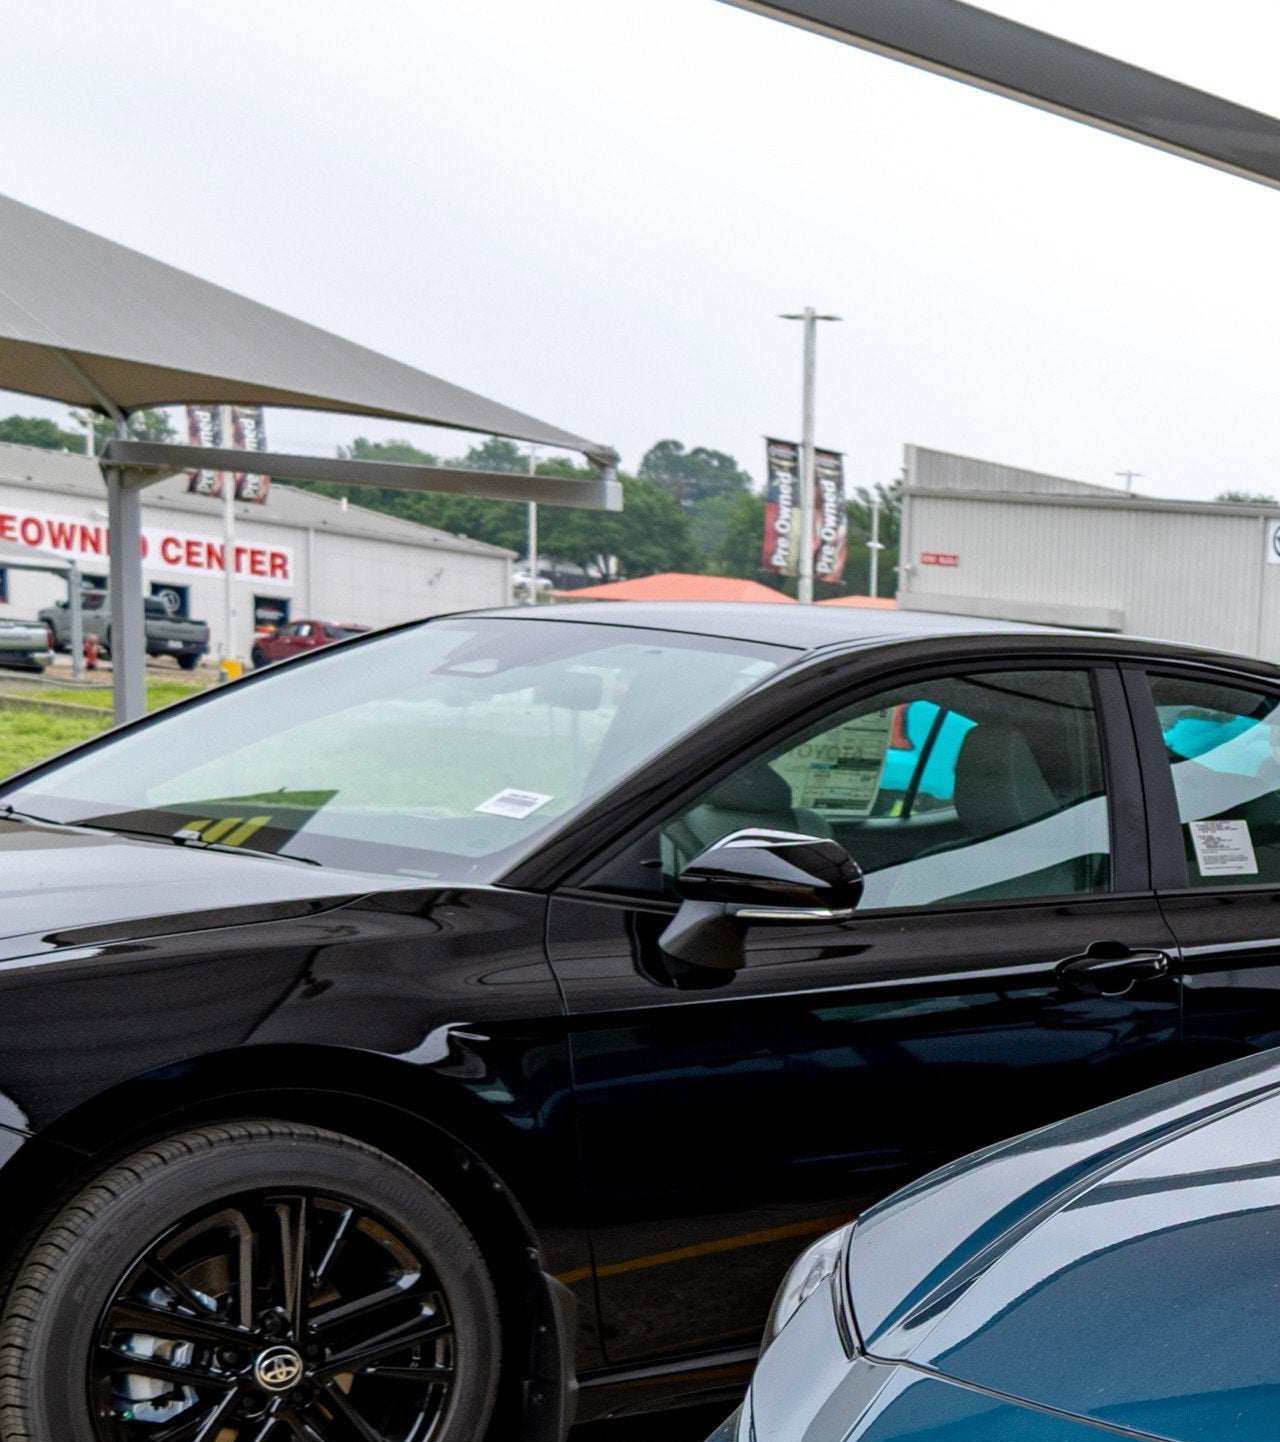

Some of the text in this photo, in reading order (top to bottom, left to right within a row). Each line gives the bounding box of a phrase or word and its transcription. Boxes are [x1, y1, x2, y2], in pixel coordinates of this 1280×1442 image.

[774, 471, 792, 534] Owned
[820, 479, 838, 541] Owned
[161, 536, 290, 580] CENTER
[771, 536, 790, 568] Pre
[816, 544, 836, 574] Pre
